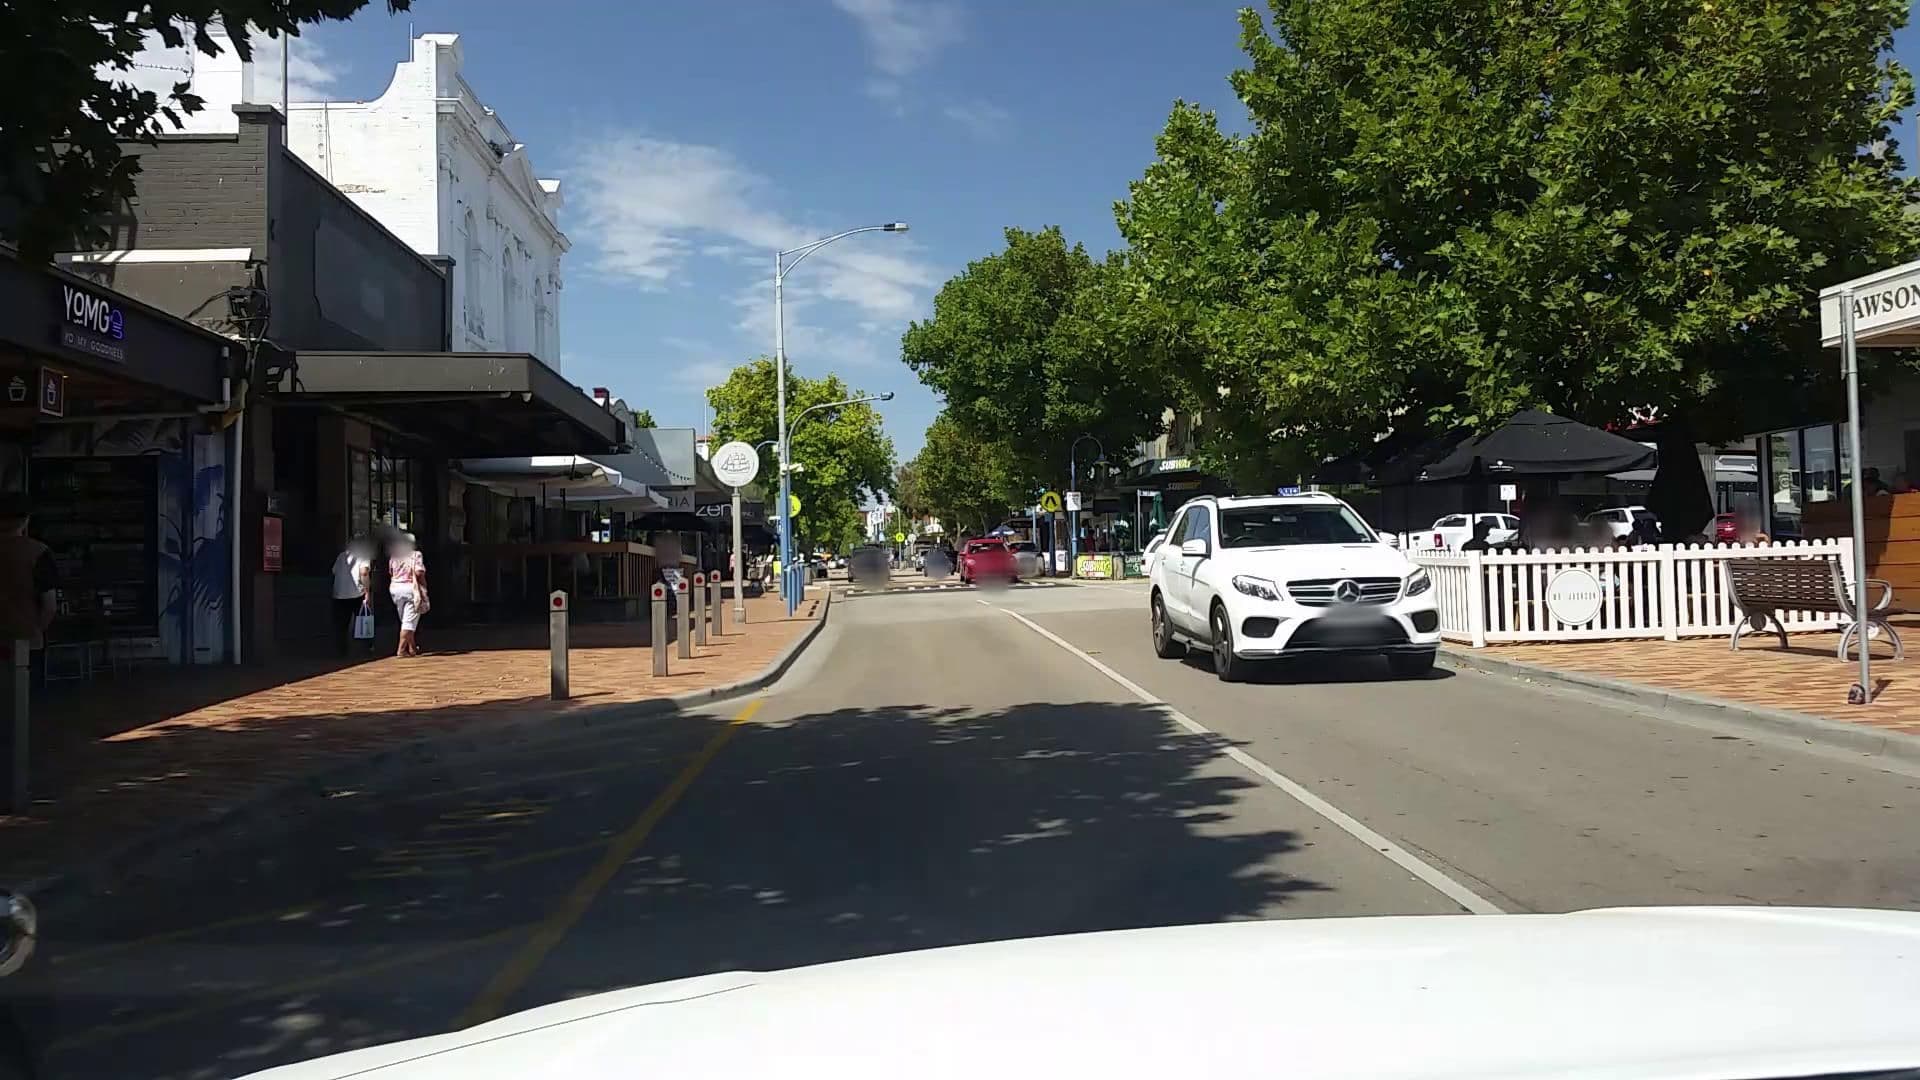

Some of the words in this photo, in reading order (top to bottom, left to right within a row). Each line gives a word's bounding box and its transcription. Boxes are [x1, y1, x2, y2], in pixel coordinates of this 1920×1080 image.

[63, 284, 110, 333] YOMG
[1159, 458, 1192, 471] SUBWAY
[1166, 481, 1201, 491] SUB
[696, 503, 733, 517] zen
